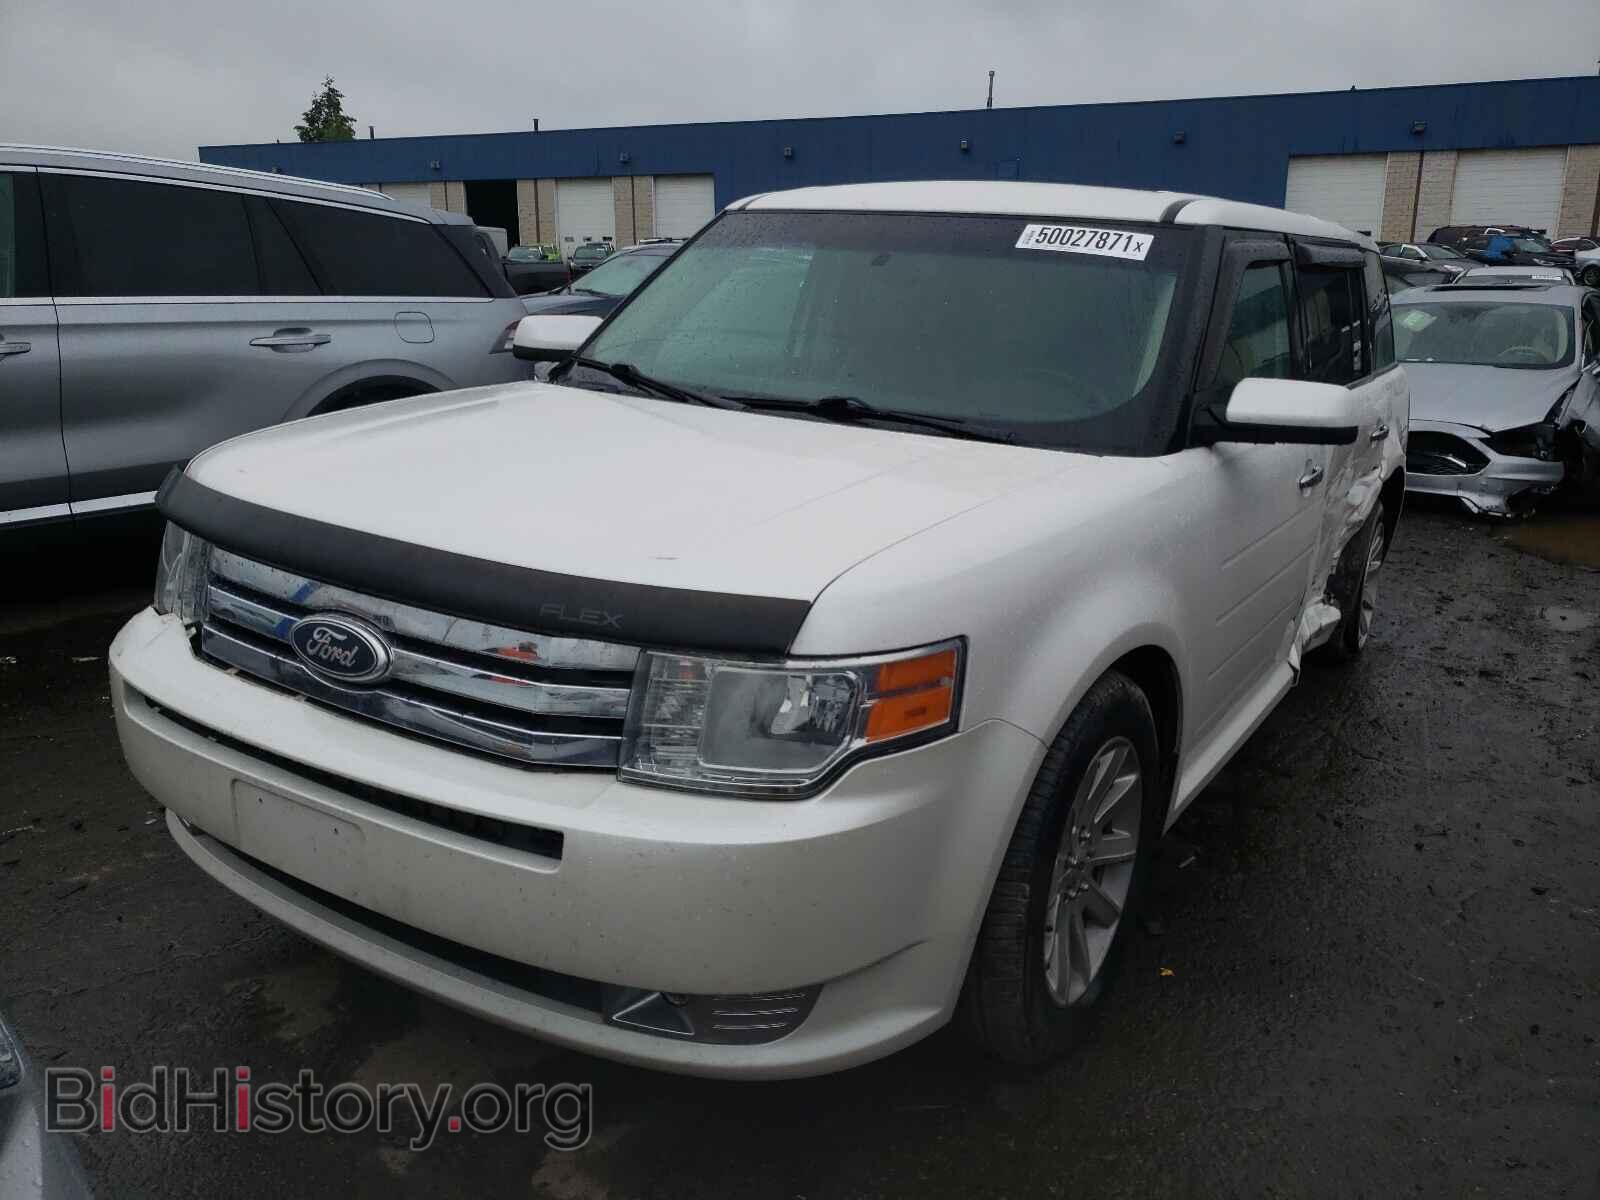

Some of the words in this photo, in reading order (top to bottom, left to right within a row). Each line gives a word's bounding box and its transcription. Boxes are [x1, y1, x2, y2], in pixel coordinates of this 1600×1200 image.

[1035, 227, 1134, 252] 50027871
[539, 603, 624, 628] FLEX
[306, 626, 358, 667] Ford
